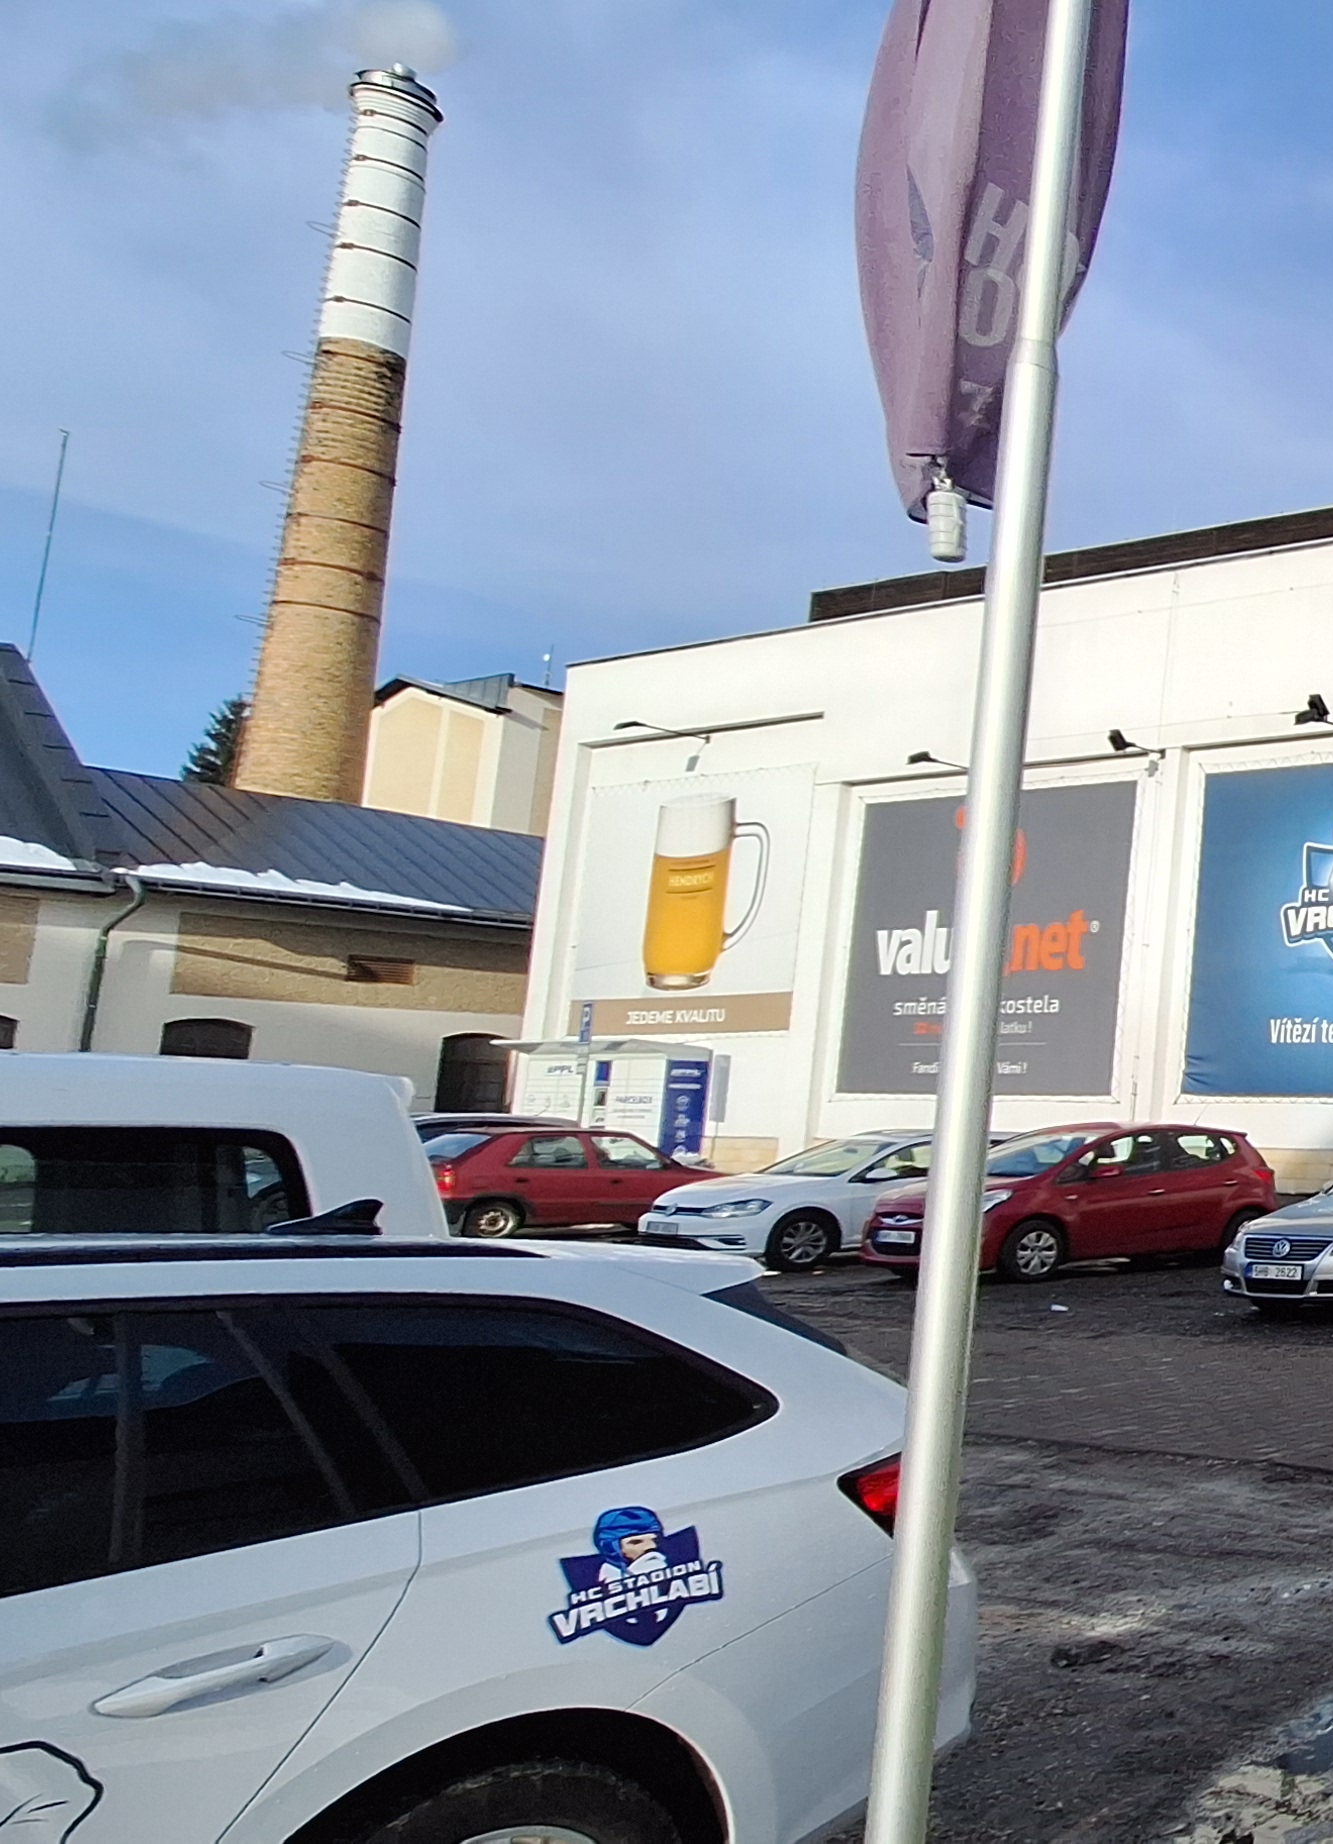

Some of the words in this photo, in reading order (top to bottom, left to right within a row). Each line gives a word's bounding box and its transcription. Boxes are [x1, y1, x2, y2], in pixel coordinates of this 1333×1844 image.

[1304, 888, 1330, 903] HC
[625, 1010, 673, 1025] JEDEME
[675, 1008, 726, 1023] KVALITU
[1270, 1016, 1319, 1044] Vítězí
[571, 1586, 603, 1604] HC
[608, 1560, 701, 1594] STADION
[553, 1562, 720, 1637] VRCHLABÍ
